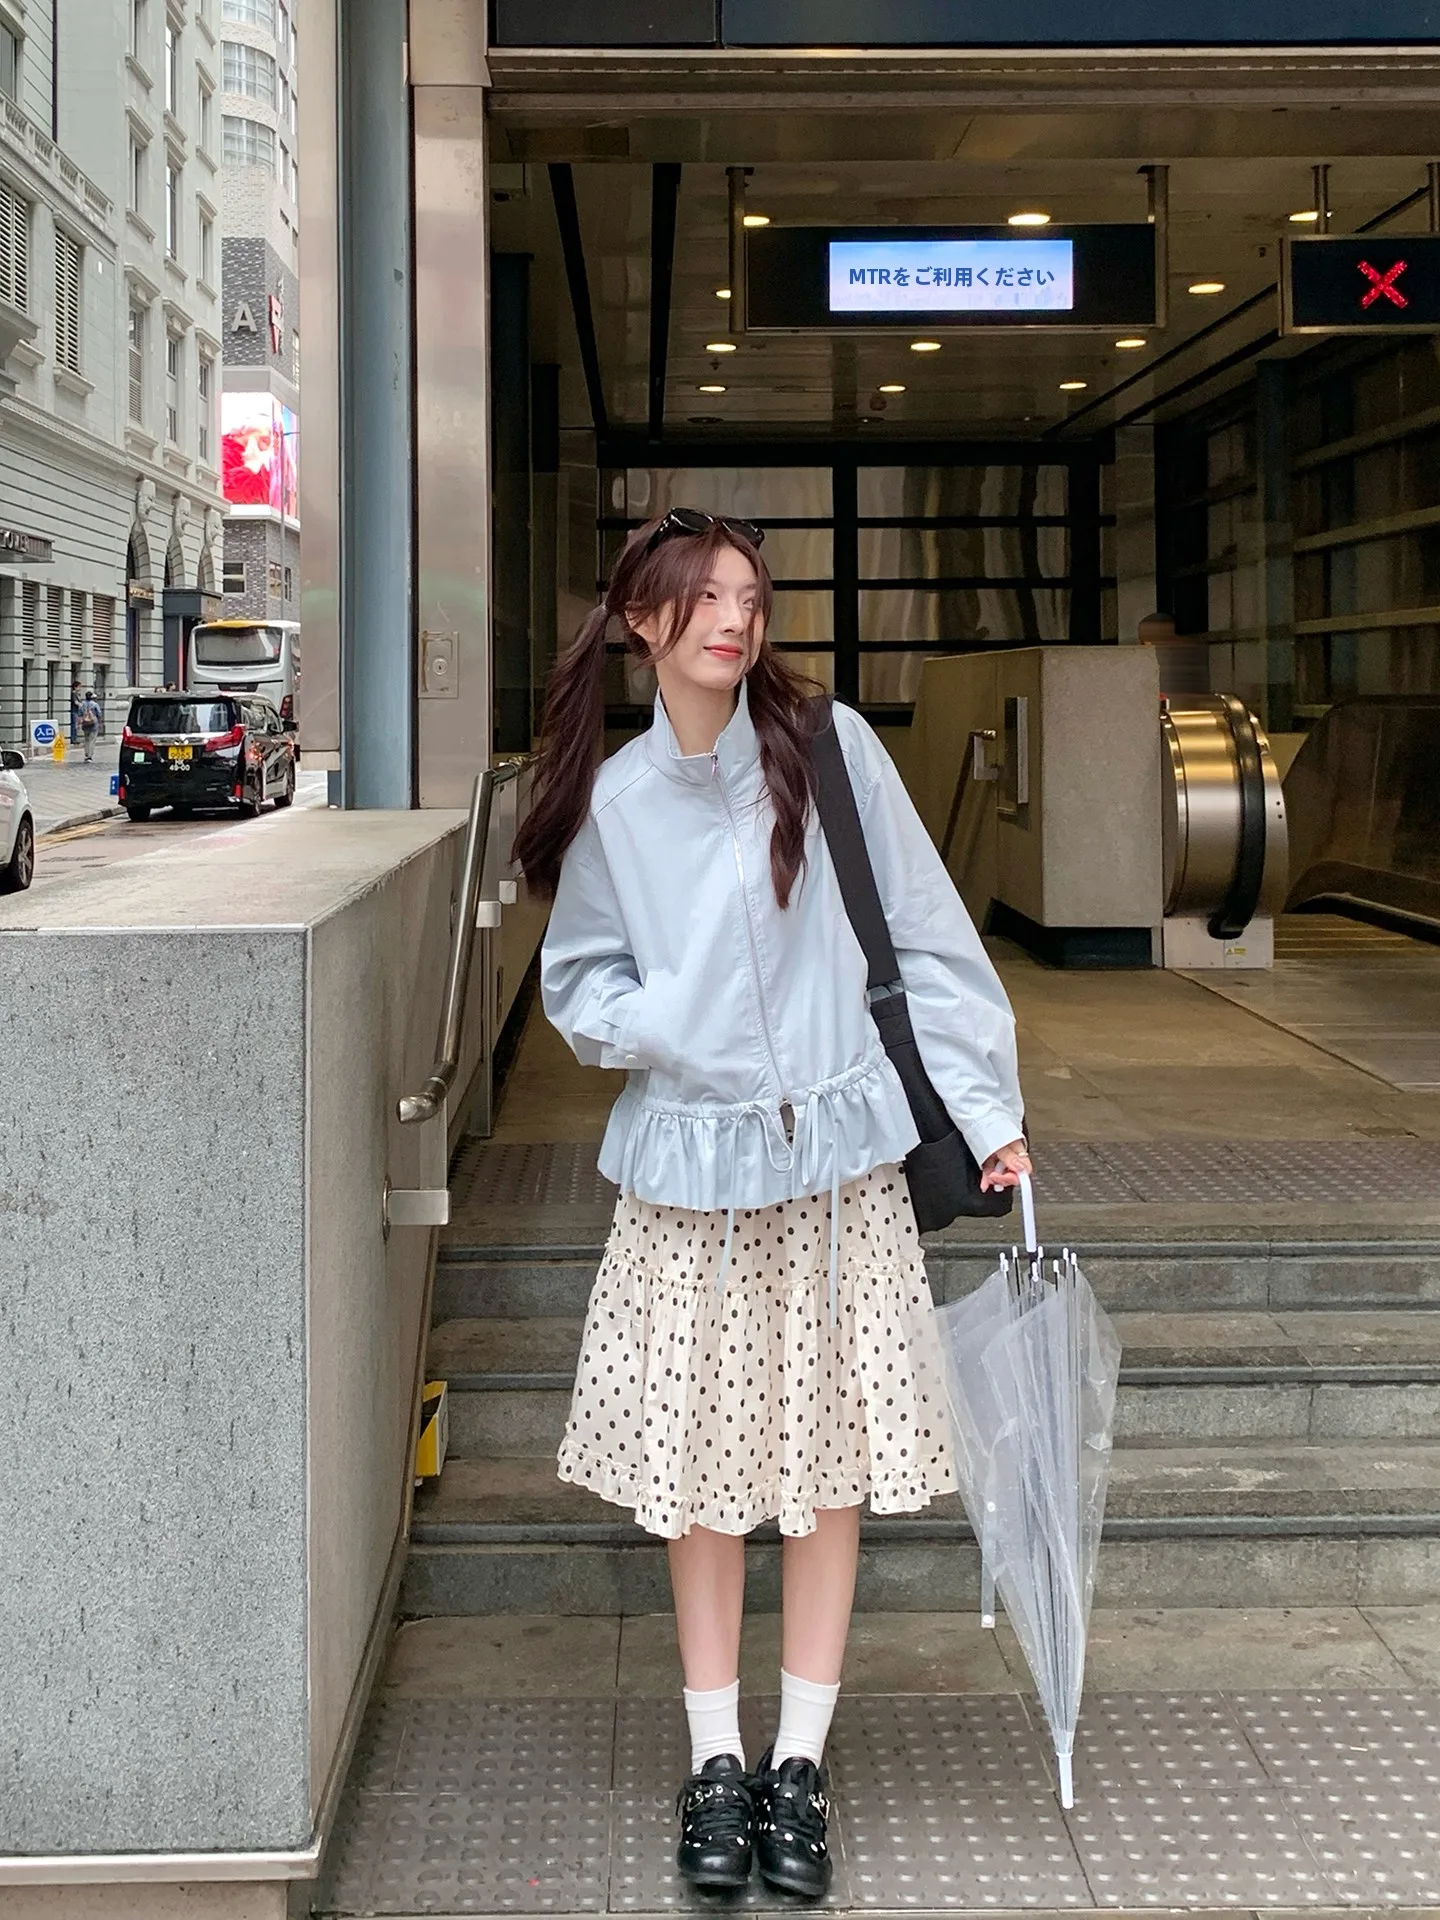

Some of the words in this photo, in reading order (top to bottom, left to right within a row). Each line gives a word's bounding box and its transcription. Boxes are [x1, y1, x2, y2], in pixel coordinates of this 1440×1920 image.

[848, 265, 1055, 288] MTRをご利用ください
[36, 727, 54, 737] 入口
